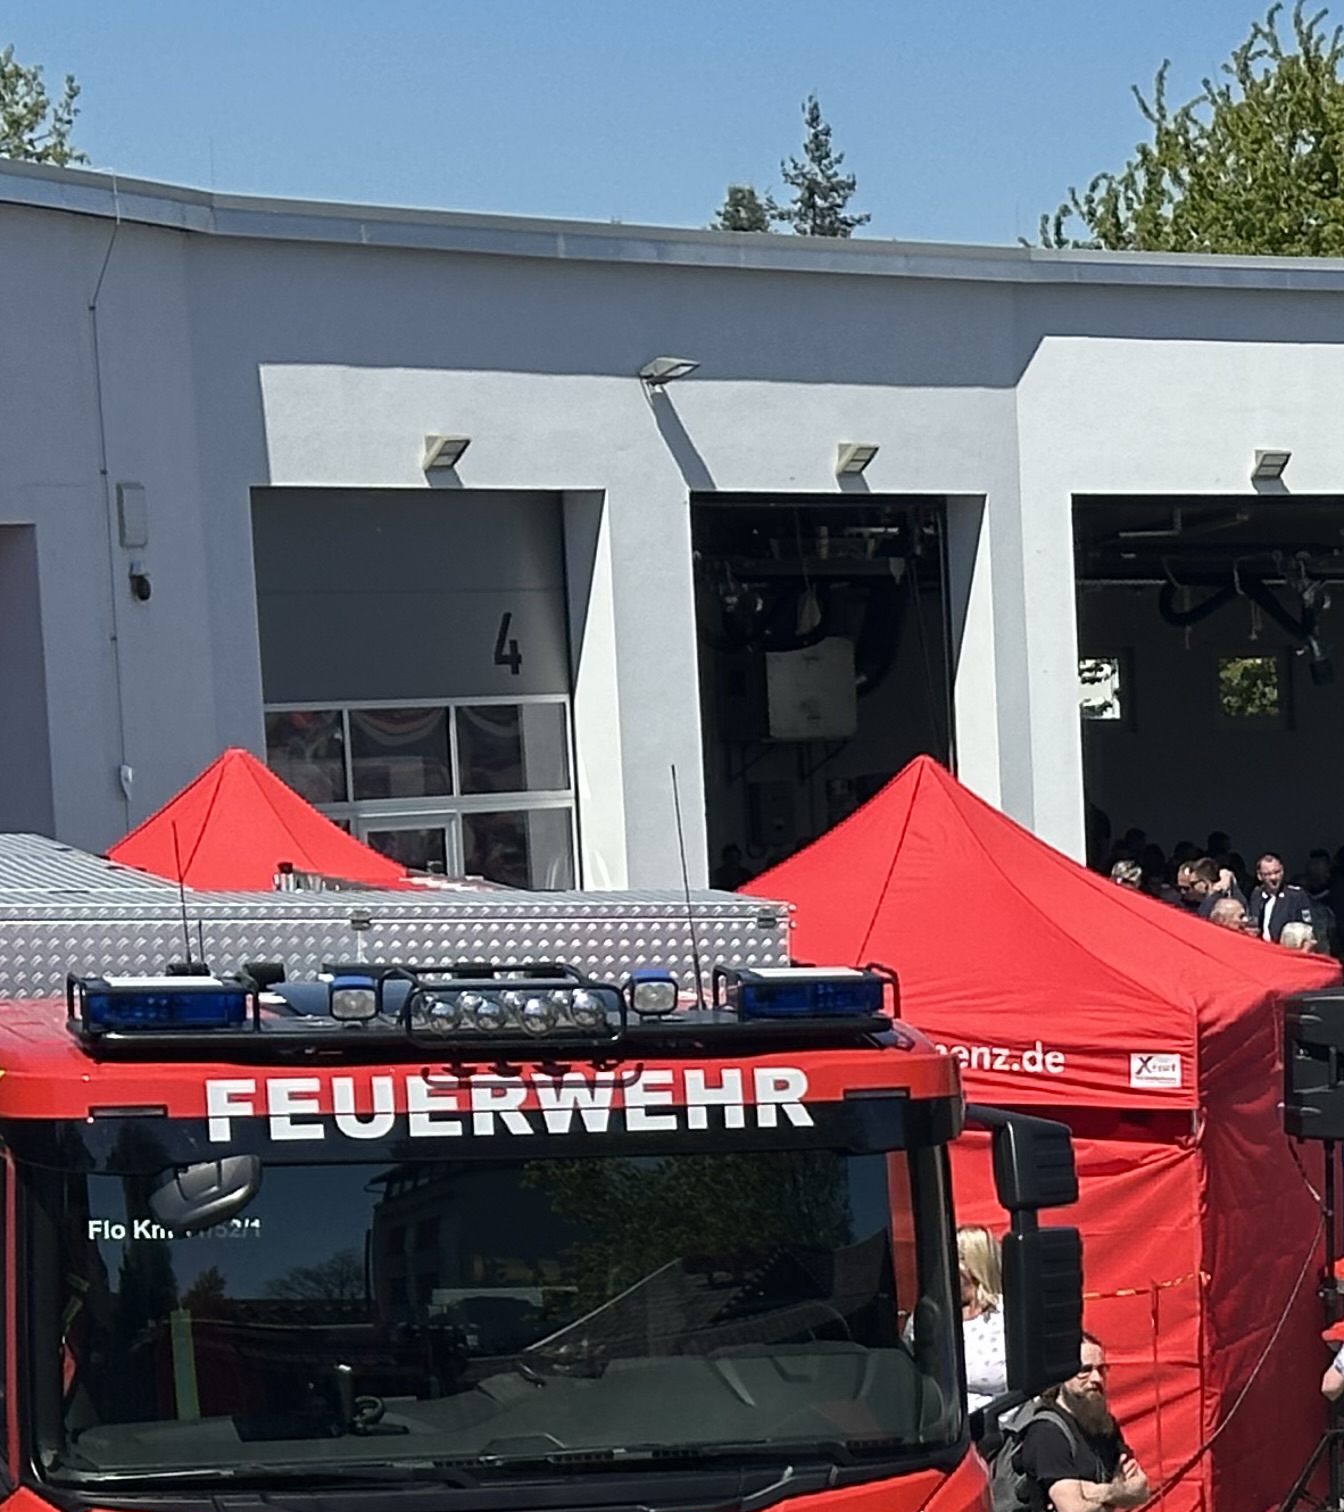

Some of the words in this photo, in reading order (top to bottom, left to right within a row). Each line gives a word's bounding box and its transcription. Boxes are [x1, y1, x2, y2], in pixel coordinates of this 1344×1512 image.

[495, 612, 522, 675] 4
[205, 1067, 814, 1142] FEUERWEHR
[88, 1220, 126, 1240] Flo
